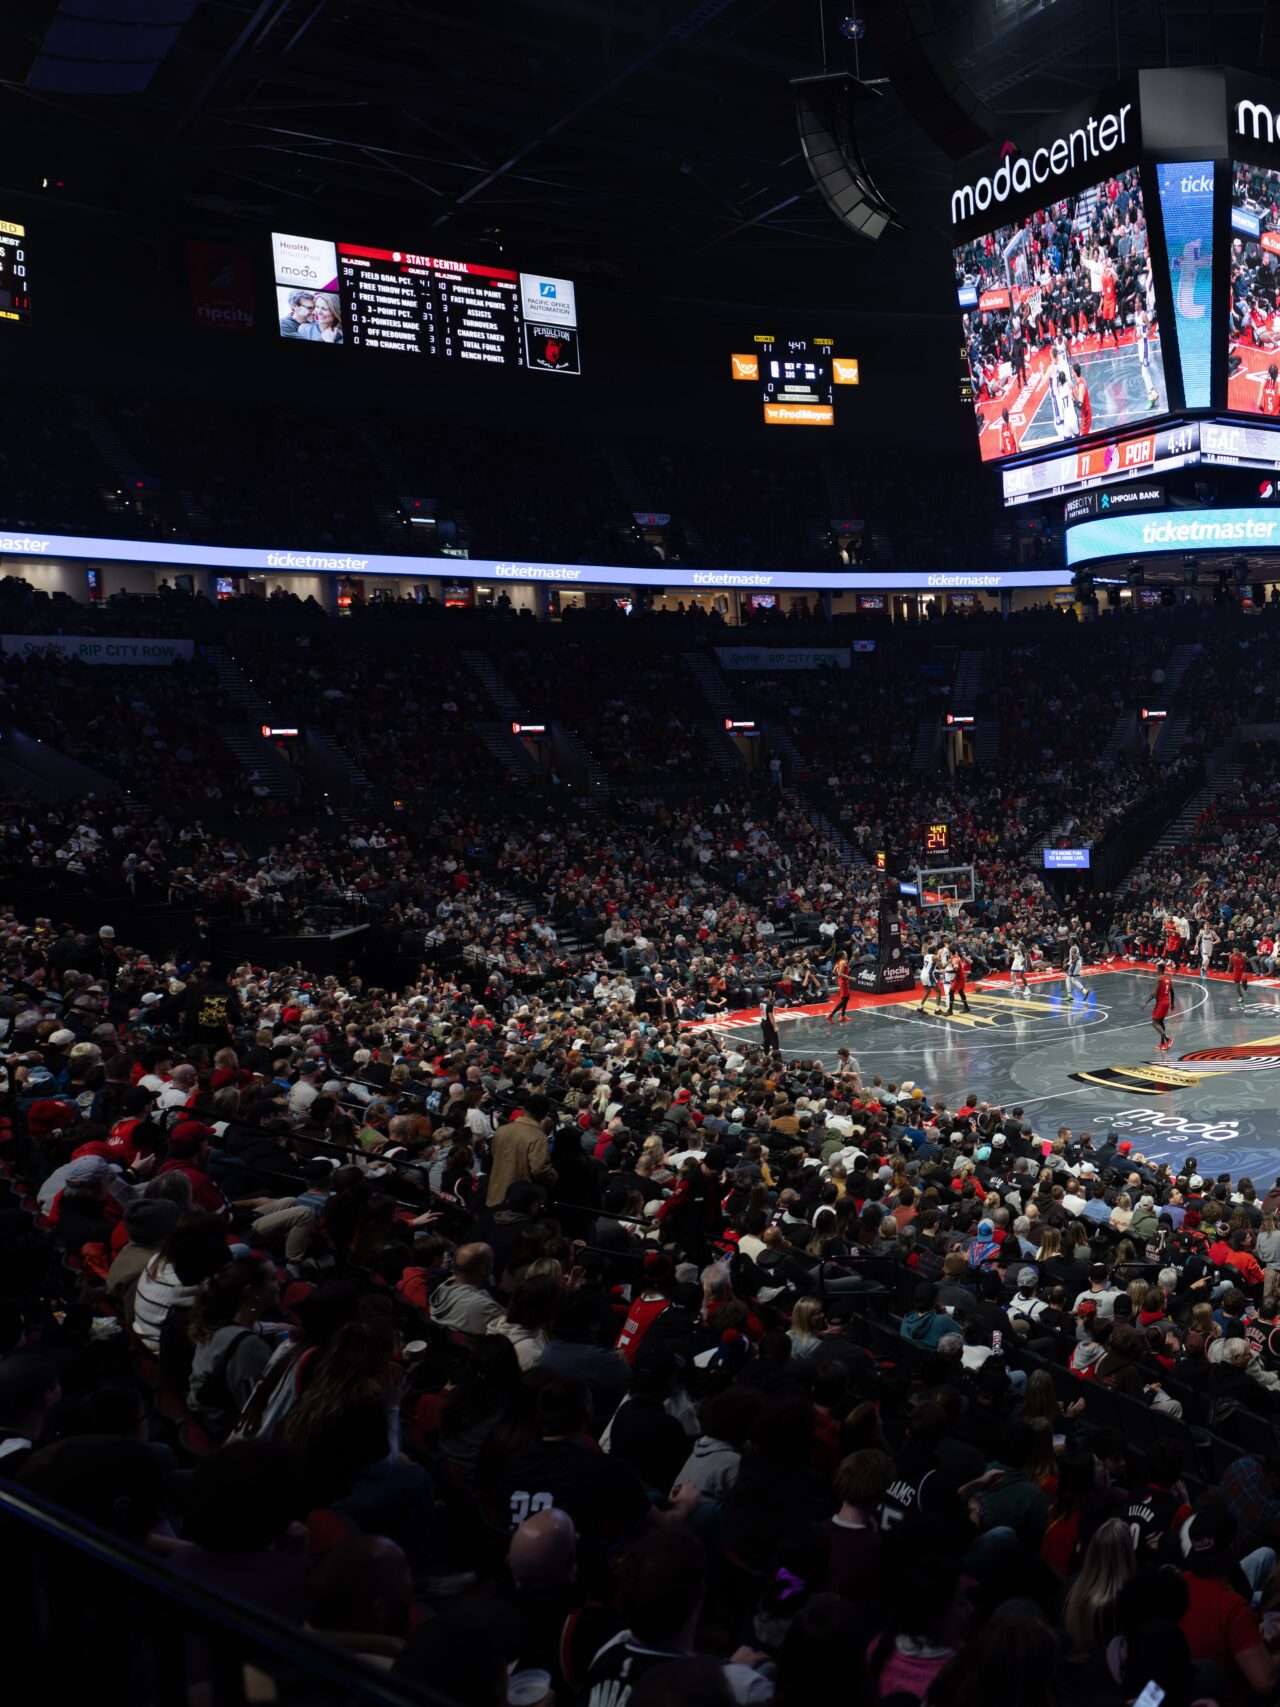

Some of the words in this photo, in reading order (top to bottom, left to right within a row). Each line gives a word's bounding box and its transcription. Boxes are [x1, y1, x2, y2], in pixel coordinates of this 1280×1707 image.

[280, 241, 309, 252] Health
[341, 257, 371, 267] BLAZERS
[408, 268, 430, 276] GUEST
[406, 254, 430, 267] STATS
[433, 258, 468, 273] CENTRAL
[281, 265, 317, 279] moda
[361, 271, 380, 281] FIELD
[381, 273, 397, 283] GOAL
[435, 272, 462, 281] BLAZERS
[497, 282, 517, 290] GUEST
[359, 282, 376, 292] FREE
[377, 285, 400, 295] THROW
[453, 285, 475, 296] POINTS
[475, 288, 483, 296] IN
[483, 289, 502, 299] PAINT
[359, 292, 374, 302] FREE
[375, 295, 400, 306] THROWS
[401, 298, 418, 308] MADE
[450, 296, 465, 304] FAST
[465, 298, 485, 307] BREAK
[485, 300, 506, 310] POINTS
[527, 298, 550, 307] PACIFIC
[550, 300, 571, 309] OFFICE
[198, 303, 254, 326] ripcity
[467, 309, 492, 319] ASSISTS
[529, 304, 571, 315] AUTOMATION
[403, 321, 420, 331] MADE
[462, 318, 498, 331] TURNOVERS
[367, 328, 380, 336] OFF
[381, 330, 416, 341] REBOUNDS
[457, 329, 486, 340] CHARGES
[486, 332, 505, 342] TAKEN
[533, 326, 570, 342] PENDLETON
[365, 339, 379, 348] 2ND
[380, 341, 406, 351] CHANCE
[463, 341, 481, 350] TOTAL
[481, 343, 502, 352] FOULS
[788, 341, 806, 351] 4:47
[461, 351, 482, 361] BENCH
[482, 354, 505, 363] POINTS
[1125, 441, 1150, 462] POR
[1167, 430, 1192, 453] 4:47
[1206, 427, 1241, 452] SAC
[1110, 494, 1139, 505] UMPQUA
[1139, 489, 1160, 501] BANK
[1142, 519, 1277, 544] ticketmaster
[267, 552, 369, 571] ticketmaster
[495, 564, 581, 580] ticketmaster
[693, 571, 773, 586] ticketmaster
[927, 574, 1002, 586] ticketmaster
[80, 644, 102, 656] RIP
[105, 645, 139, 657] CITY
[143, 646, 176, 657] ROW
[768, 654, 785, 664] RIP
[786, 654, 811, 664] CITY
[930, 825, 946, 833] 4:47
[928, 833, 945, 848] 24
[883, 965, 910, 979] ripcity
[1092, 1114, 1210, 1148] center
[1115, 1108, 1239, 1142] moda
